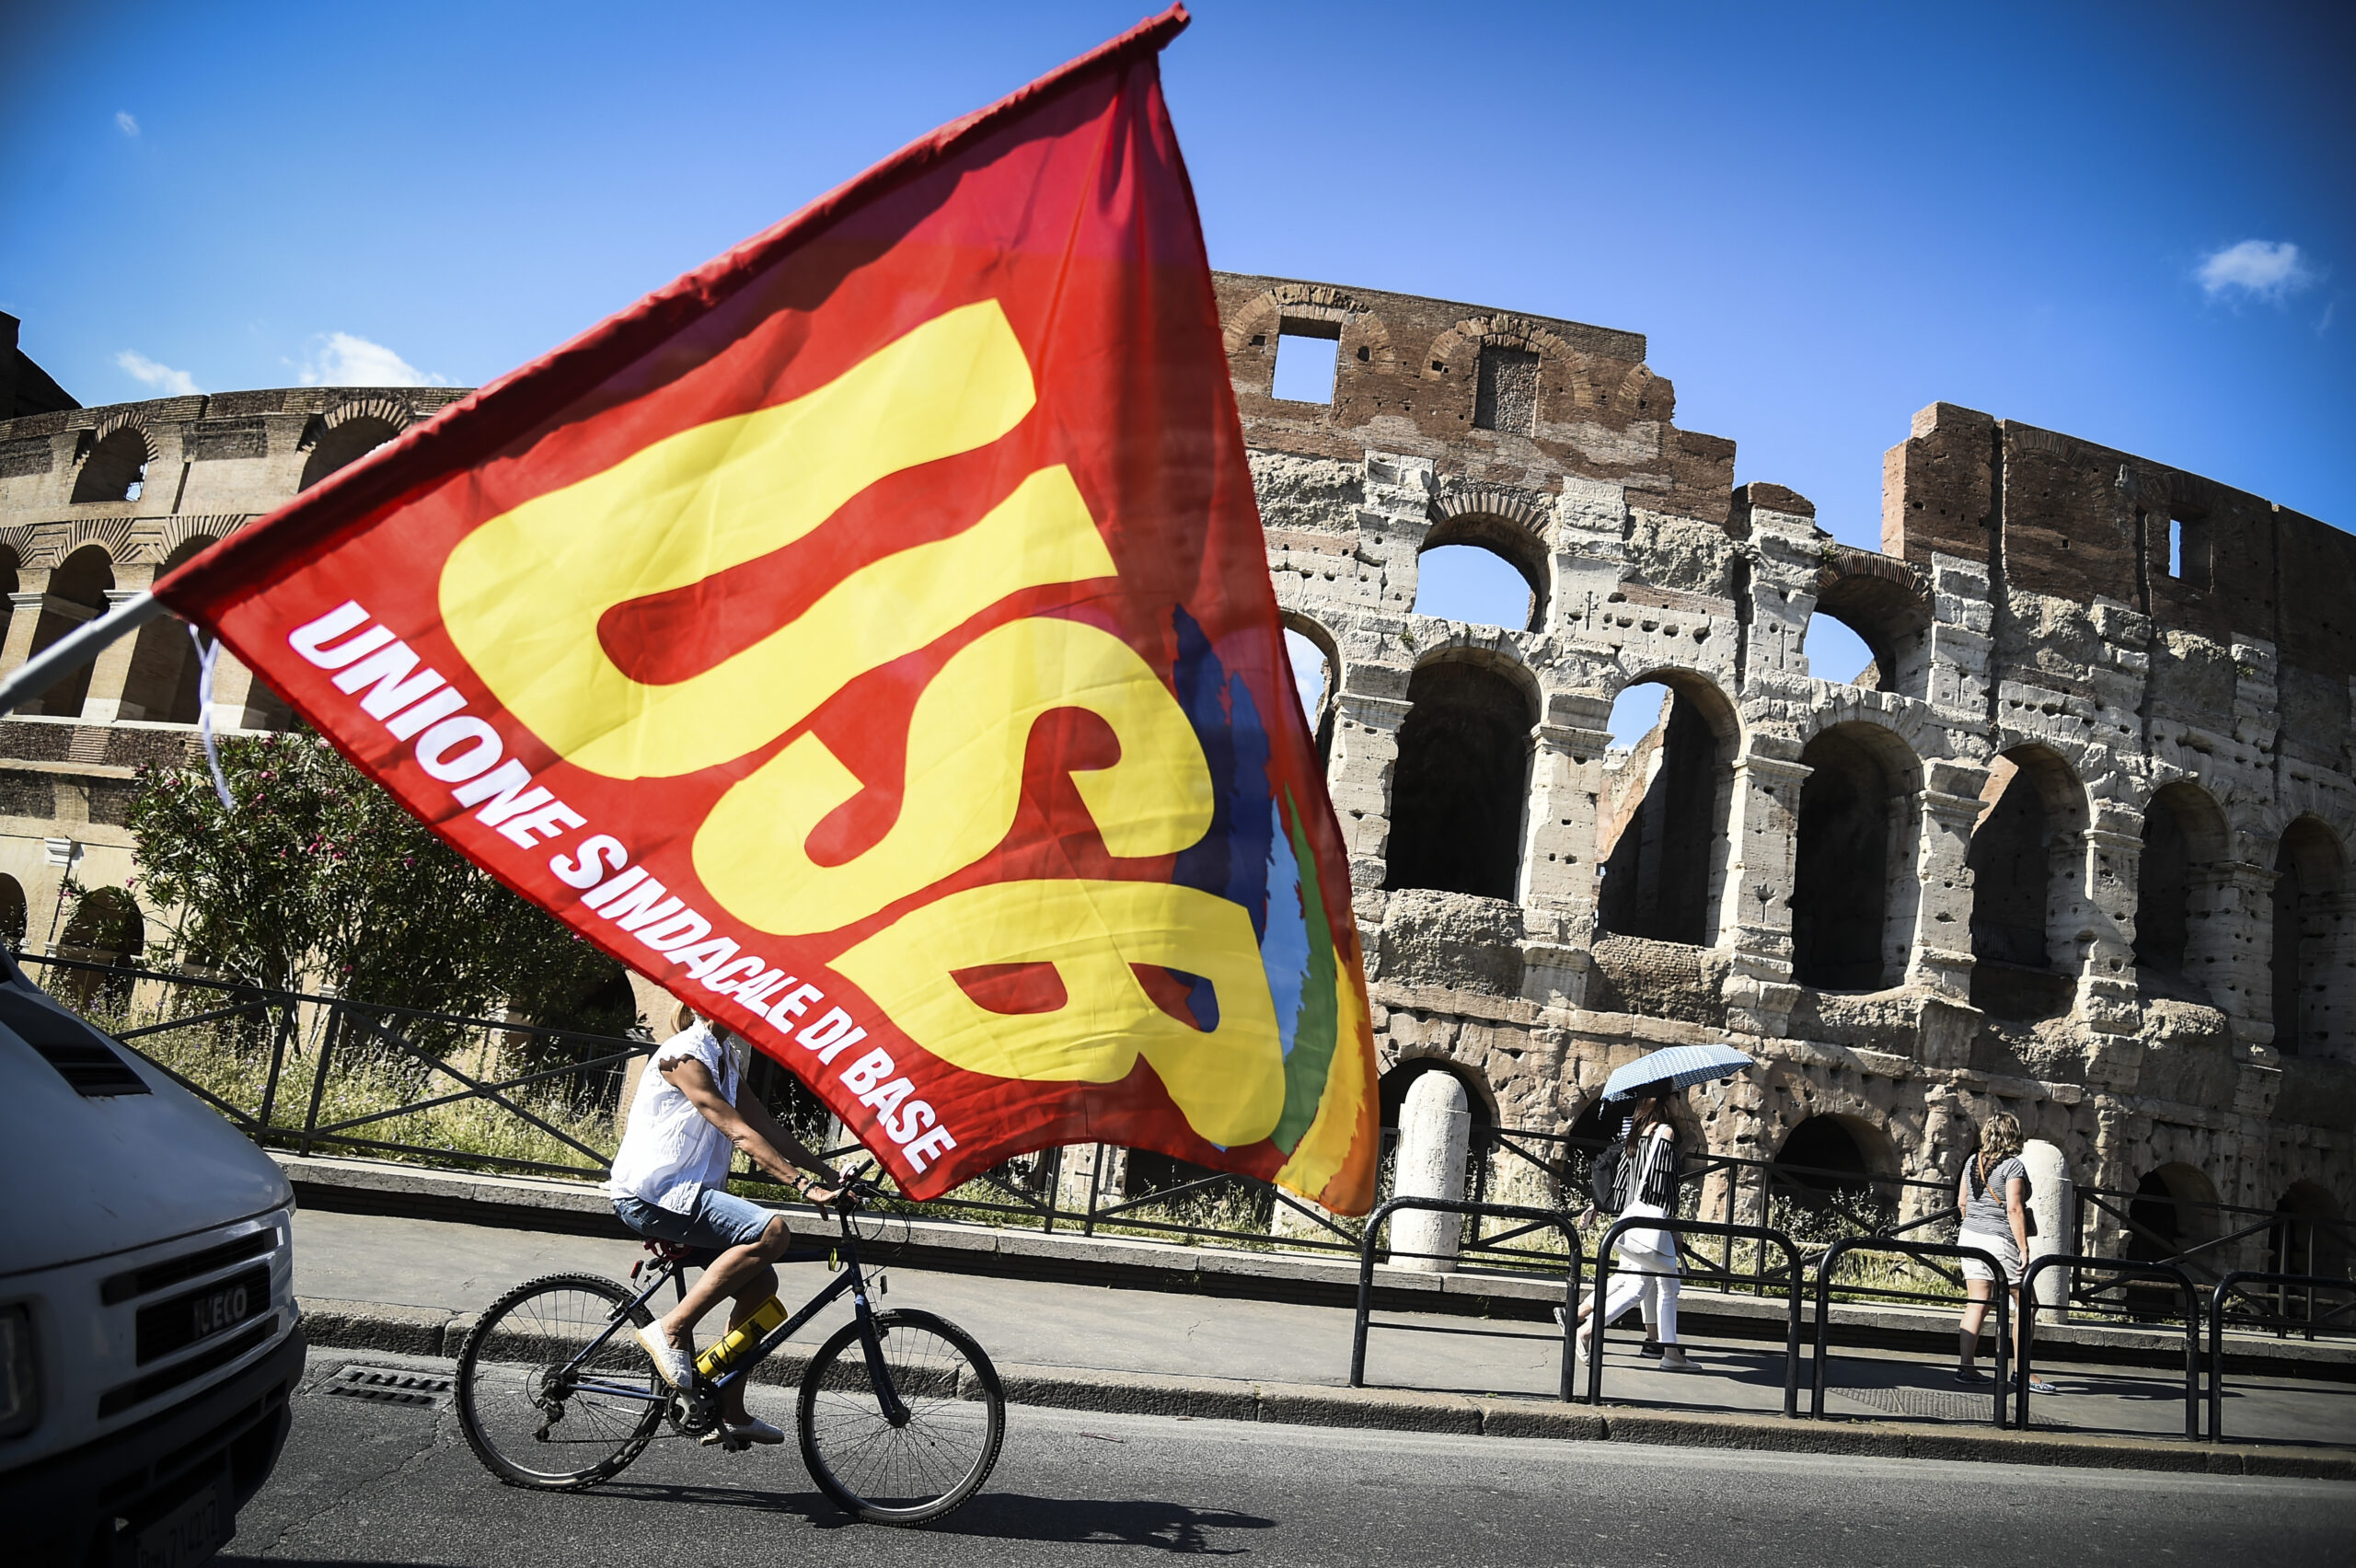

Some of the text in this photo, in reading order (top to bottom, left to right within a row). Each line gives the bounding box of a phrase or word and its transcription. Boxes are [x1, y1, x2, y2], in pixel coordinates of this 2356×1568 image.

[288, 599, 957, 1174] UNIONE SINDACALE DI BASE
[438, 299, 1286, 1146] USB
[193, 1286, 248, 1339] IVECO
